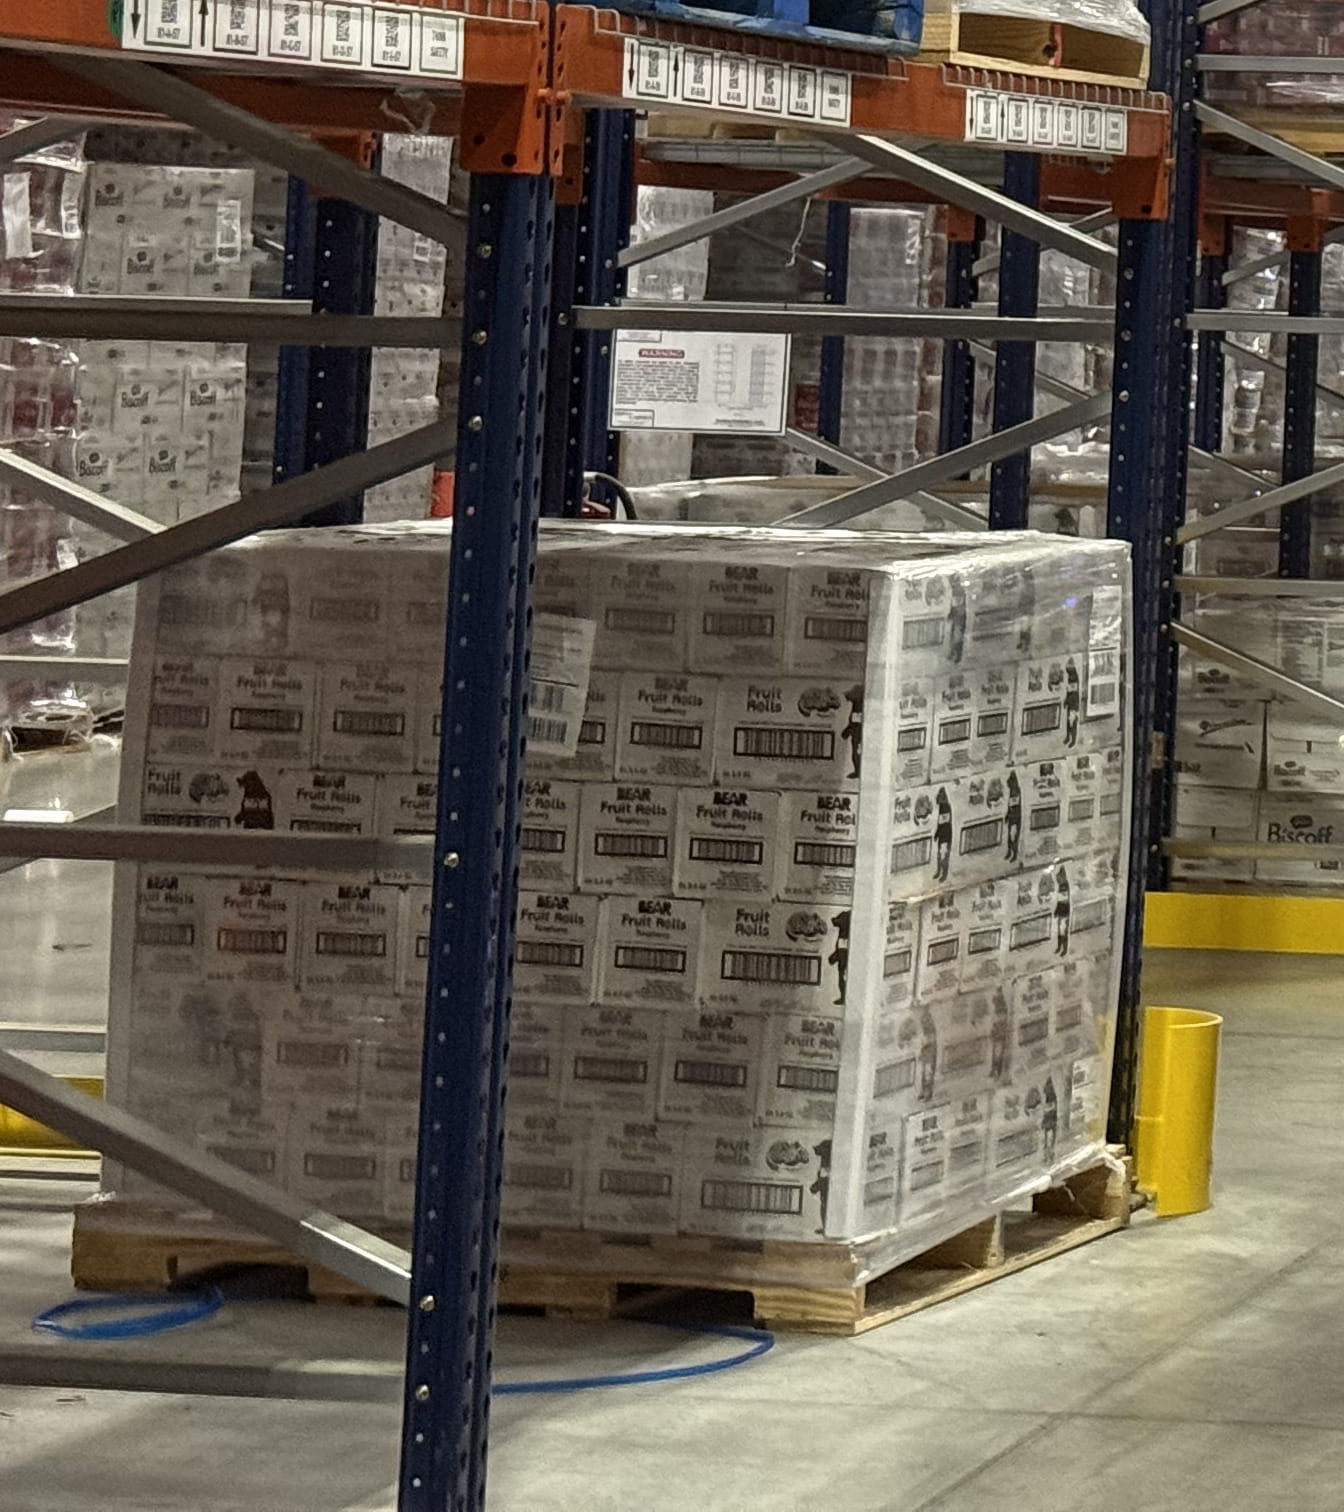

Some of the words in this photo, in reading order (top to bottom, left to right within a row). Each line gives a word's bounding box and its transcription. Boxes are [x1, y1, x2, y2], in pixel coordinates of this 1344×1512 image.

[747, 686, 782, 700] Fruit
[713, 791, 747, 806] BEAR
[817, 796, 851, 811] BEAR
[601, 800, 632, 815] Fruit
[696, 805, 728, 819] Fruit
[801, 810, 832, 824] Fruit
[835, 812, 856, 825] Rol
[1267, 821, 1334, 843] Biscoff
[536, 894, 569, 910] BEAR
[638, 900, 672, 916] BEAR
[520, 909, 551, 924] Fruit
[621, 914, 653, 928] Fruit
[736, 908, 770, 923] Fruit
[735, 922, 770, 938] Rolls
